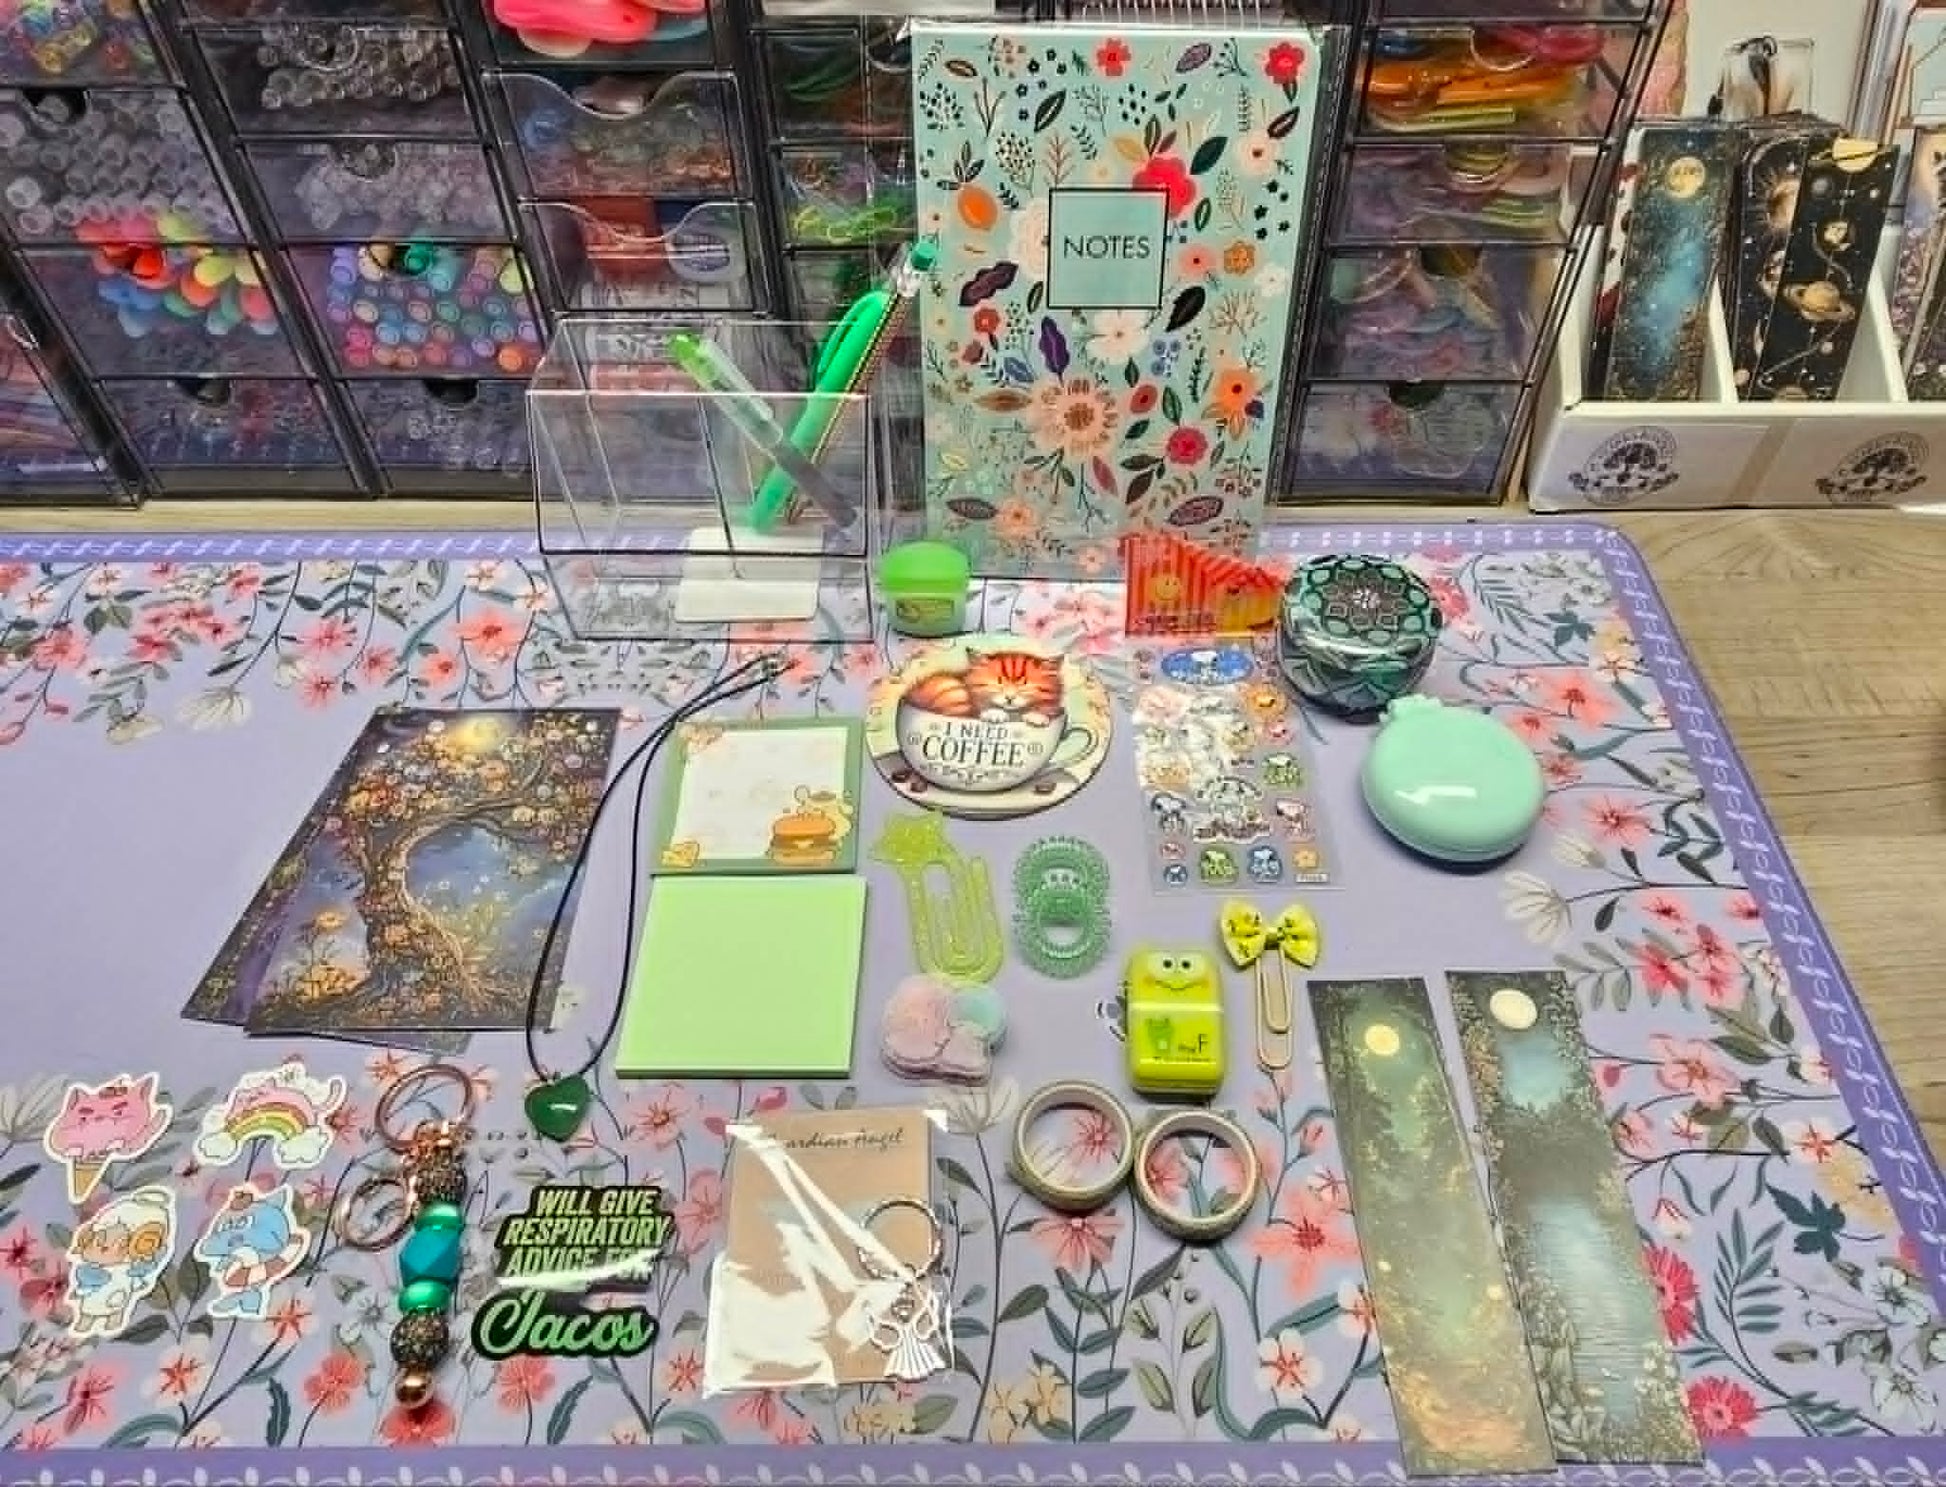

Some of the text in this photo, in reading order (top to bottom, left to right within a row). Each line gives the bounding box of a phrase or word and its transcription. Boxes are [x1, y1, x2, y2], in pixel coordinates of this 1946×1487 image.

[1063, 235, 1150, 258] NOTES
[942, 721, 1008, 739] I NEED
[922, 735, 1024, 767] COFFEE
[768, 1131, 848, 1149] ardian
[536, 1189, 658, 1216] WILL GIVE
[503, 1216, 670, 1246] RESPIRATORY
[504, 1247, 599, 1278] ADVICE
[479, 1288, 656, 1354] Tacos
